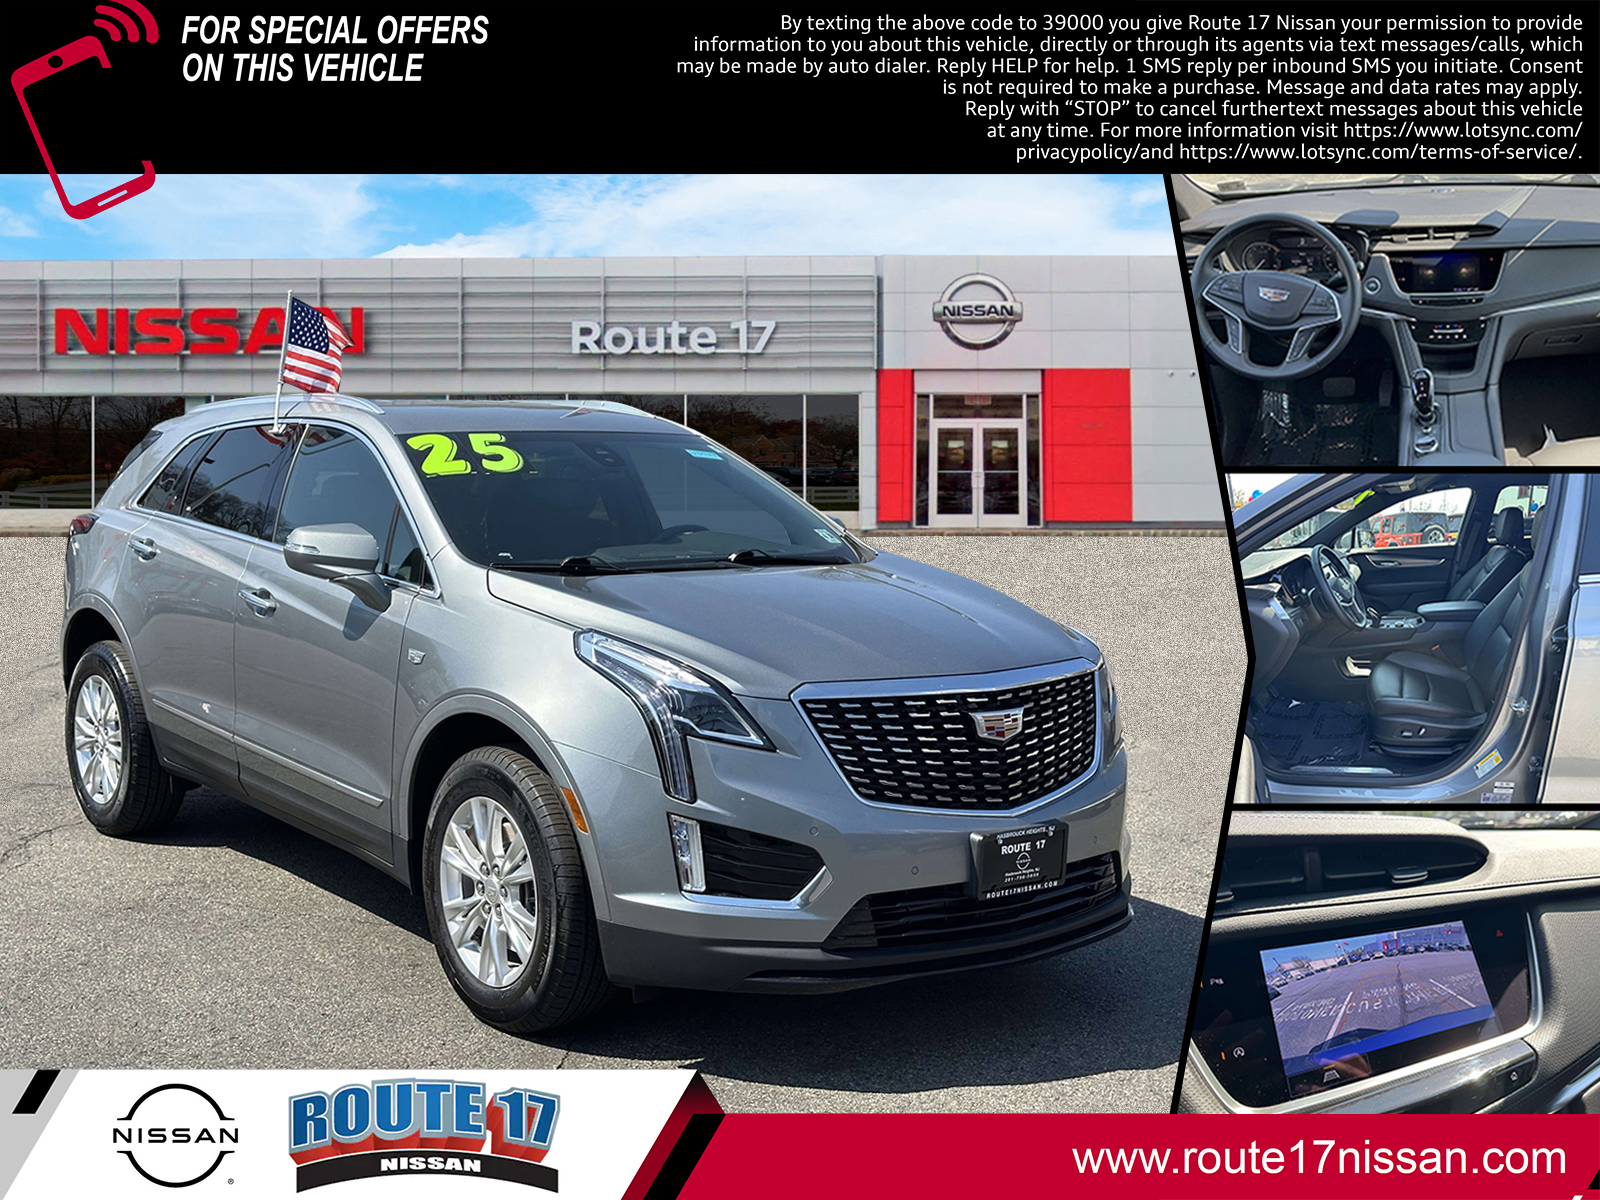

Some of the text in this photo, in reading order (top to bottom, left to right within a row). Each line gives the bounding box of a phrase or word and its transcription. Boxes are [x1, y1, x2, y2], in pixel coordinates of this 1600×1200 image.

[942, 305, 1014, 317] NISSAN
[571, 320, 776, 354] Route 17
[406, 432, 524, 476] 25
[1001, 839, 1046, 855] ROUTE 17
[985, 880, 1058, 899] ROUTE17NISSAN.COM
